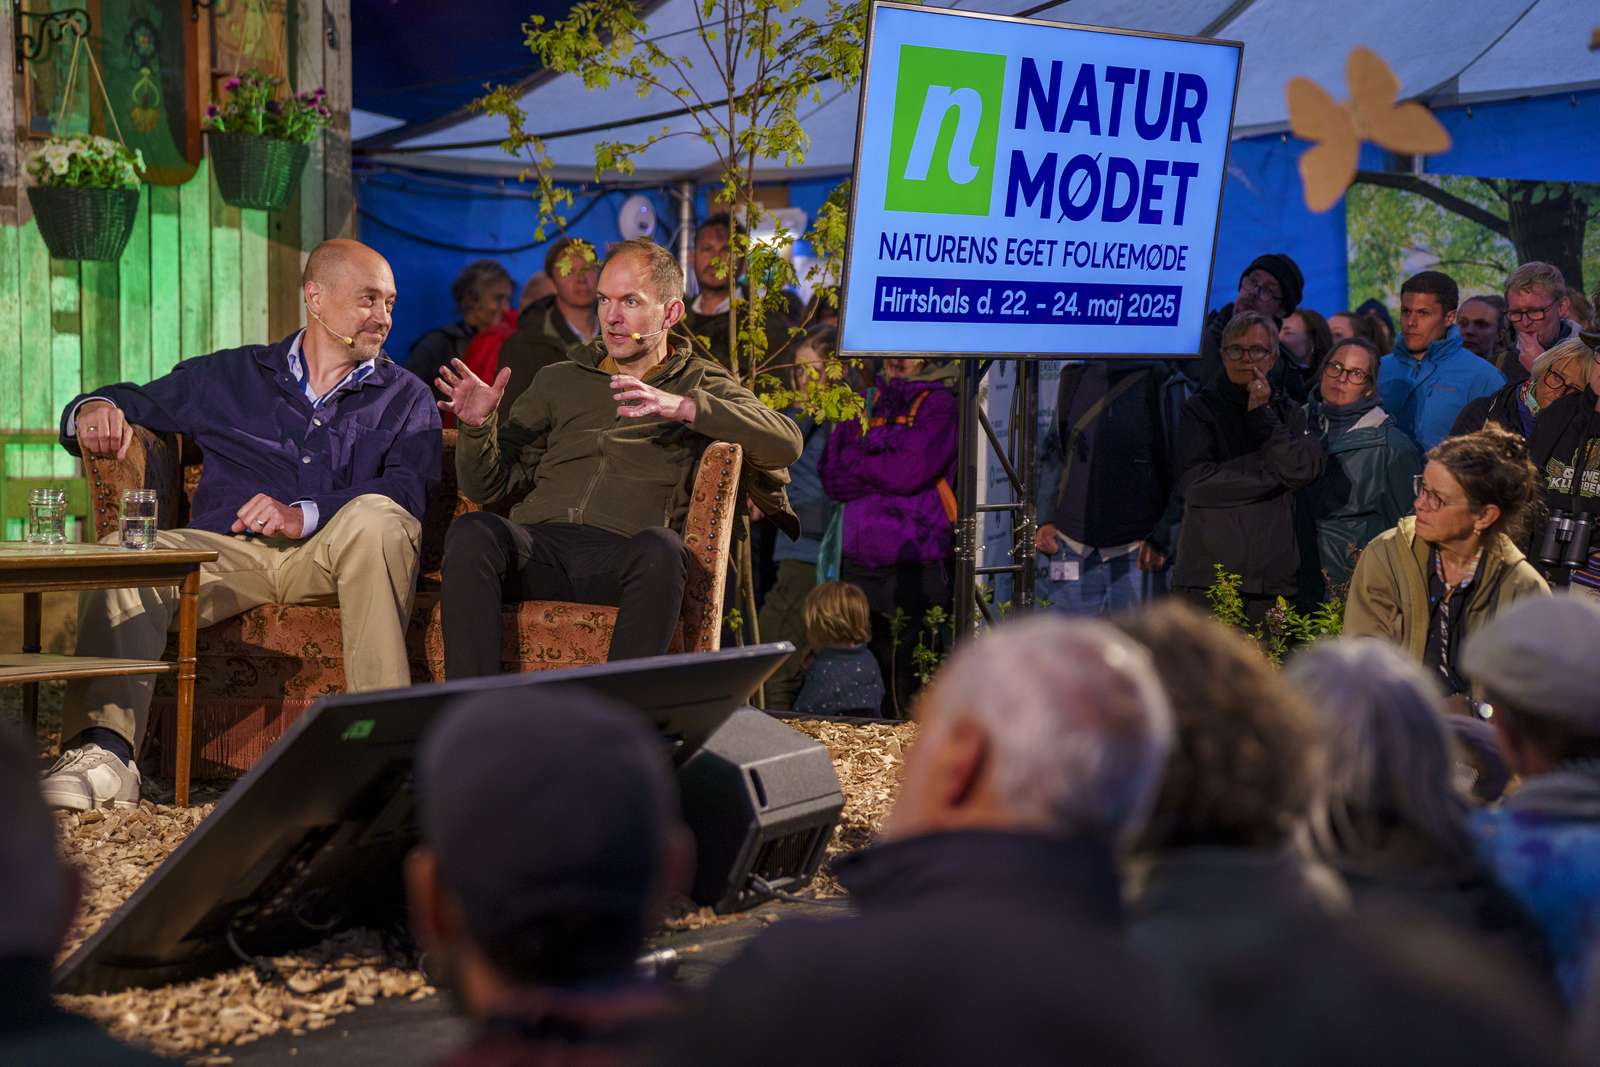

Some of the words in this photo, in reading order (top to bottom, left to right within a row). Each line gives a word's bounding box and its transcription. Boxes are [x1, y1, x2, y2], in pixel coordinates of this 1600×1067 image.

[904, 85, 983, 185] n
[1014, 57, 1208, 144] NATUR
[1004, 149, 1199, 226] MØDET
[878, 231, 999, 265] NATURENS
[1004, 237, 1058, 267] EGET
[1062, 240, 1189, 272] FOLKEMØDE
[879, 285, 970, 314] Hirtshals
[976, 287, 994, 315] d.
[999, 289, 1030, 316] 22.
[1051, 290, 1082, 317] 24.
[1087, 293, 1124, 325] maj
[1127, 292, 1177, 318] 2025
